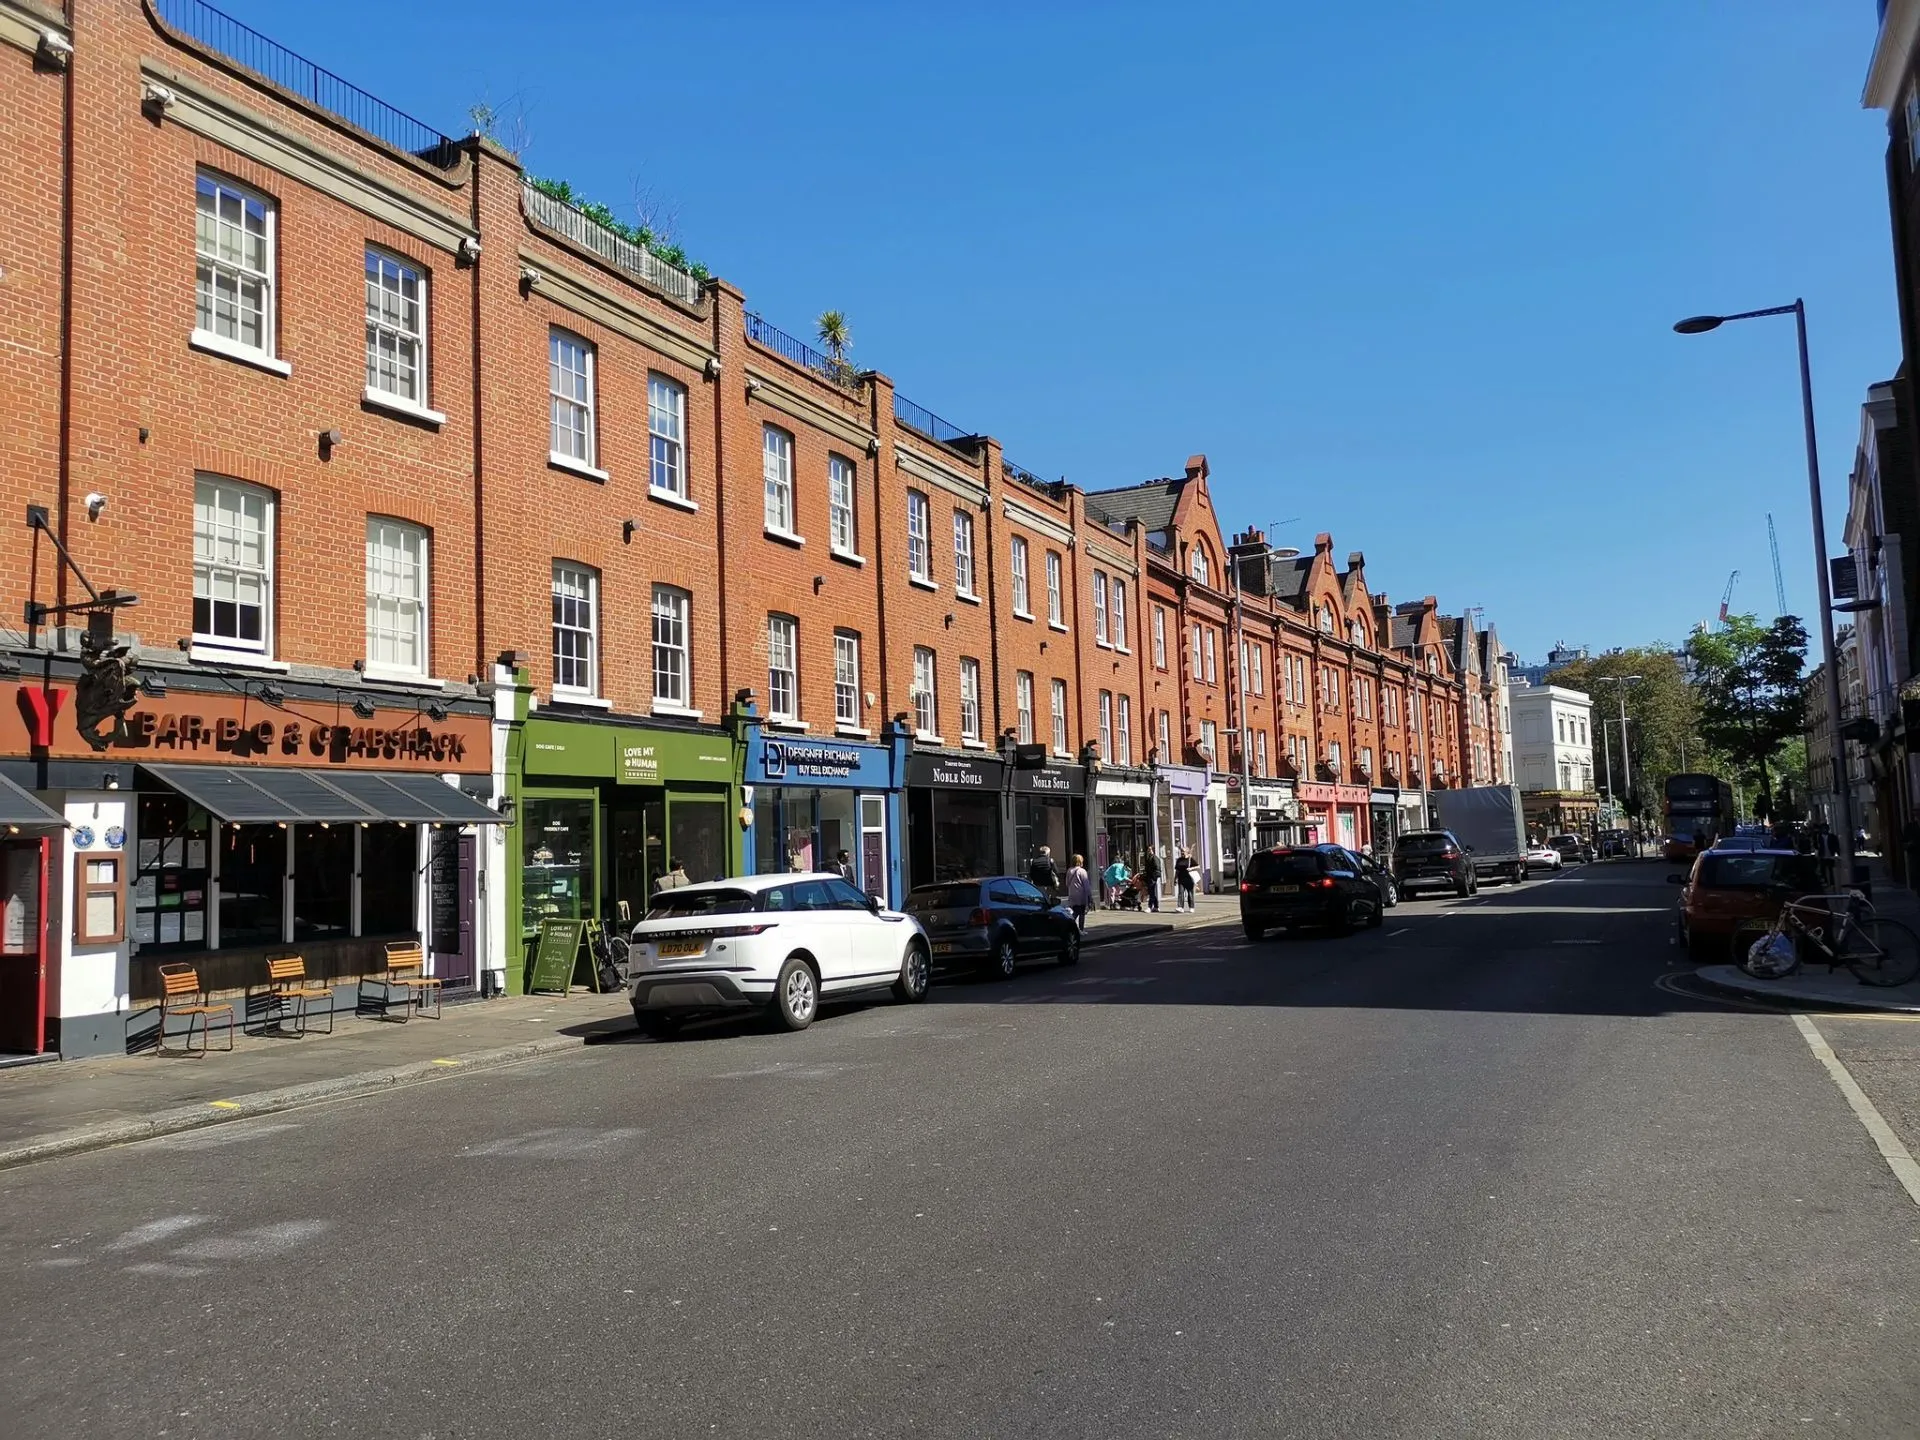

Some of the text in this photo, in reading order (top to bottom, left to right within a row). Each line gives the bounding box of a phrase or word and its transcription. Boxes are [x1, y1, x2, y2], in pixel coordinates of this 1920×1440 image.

[624, 746, 654, 757] LOVE MY
[788, 746, 860, 761] DESIGNER EXCHANGE
[631, 757, 657, 769] HUMAN
[799, 764, 850, 776] BUY SELL EXCHANGE
[933, 768, 983, 785] NOBLE SOULS
[1032, 774, 1070, 790] NOBLE SOULS
